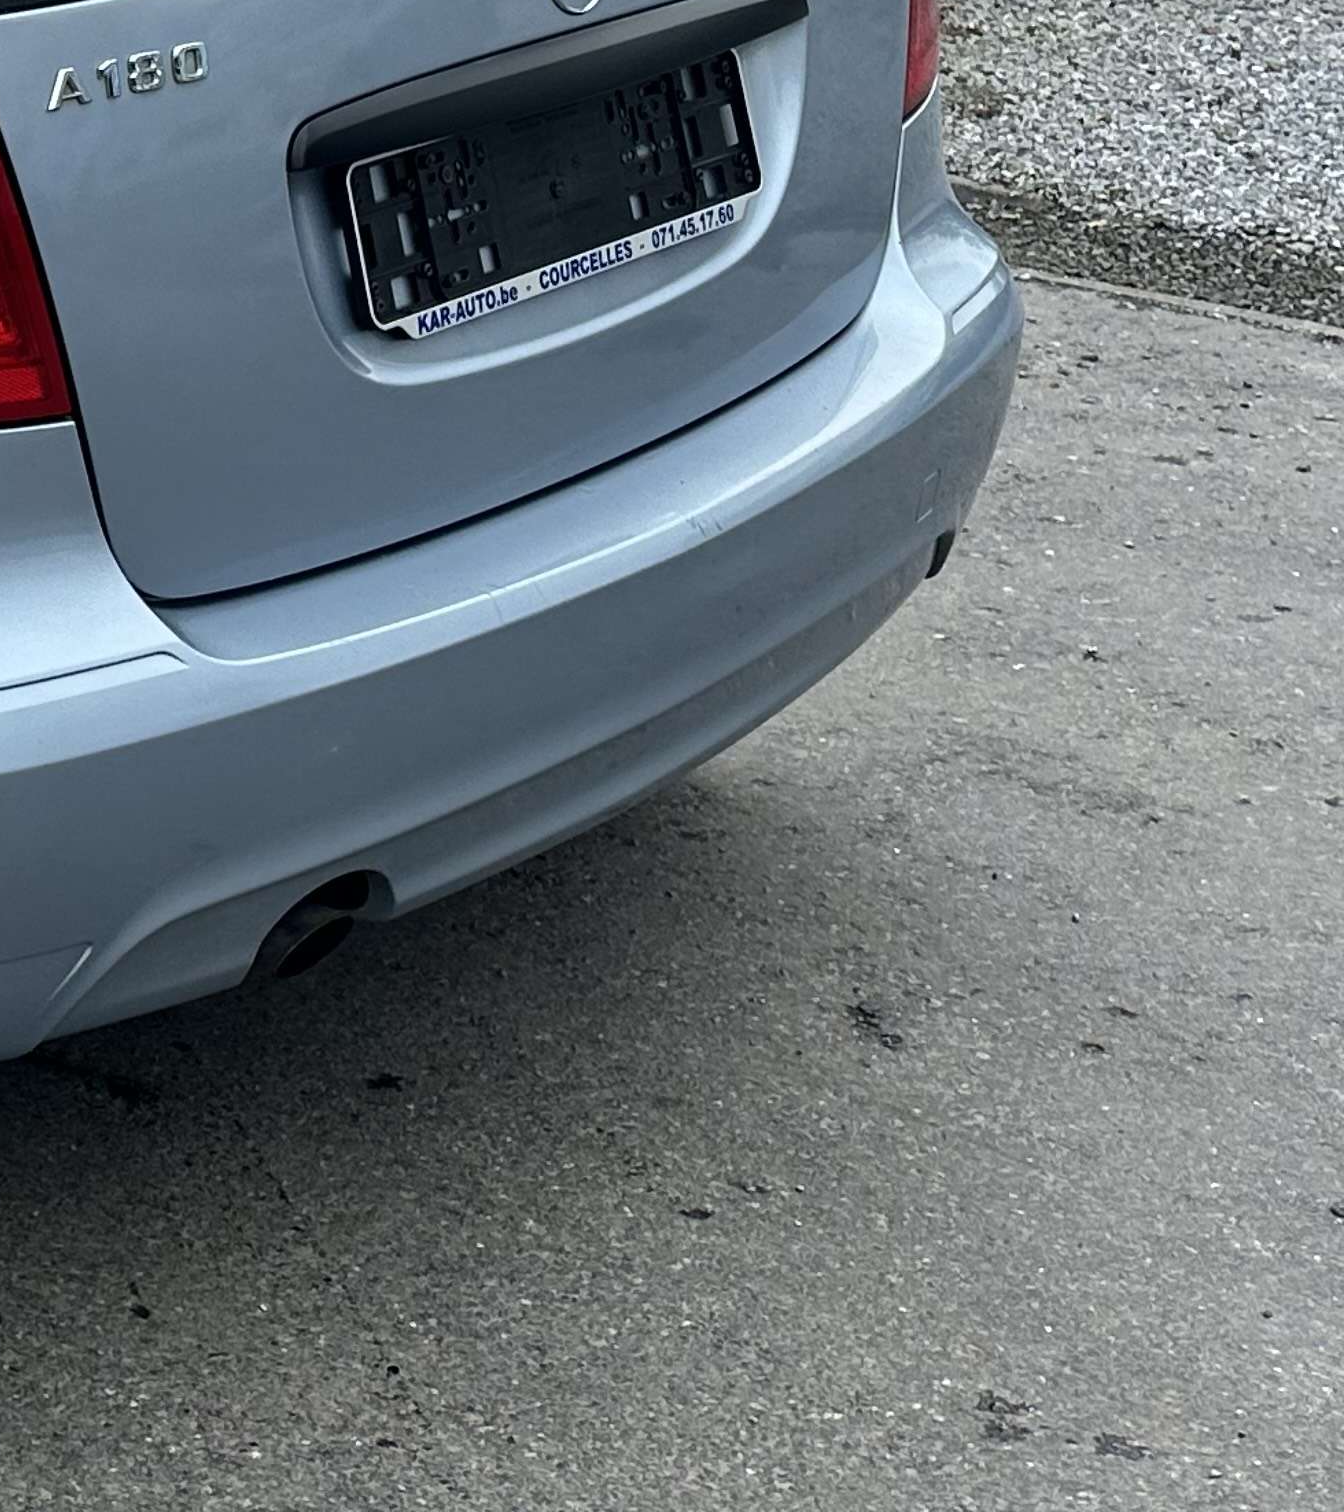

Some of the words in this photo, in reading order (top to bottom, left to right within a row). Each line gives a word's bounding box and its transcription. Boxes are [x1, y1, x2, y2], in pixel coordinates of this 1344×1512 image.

[43, 40, 210, 113] A180
[416, 285, 519, 336] KAR-AUTO.be
[538, 240, 633, 290] COURCELLES
[651, 203, 735, 249] 071.45.17.60
